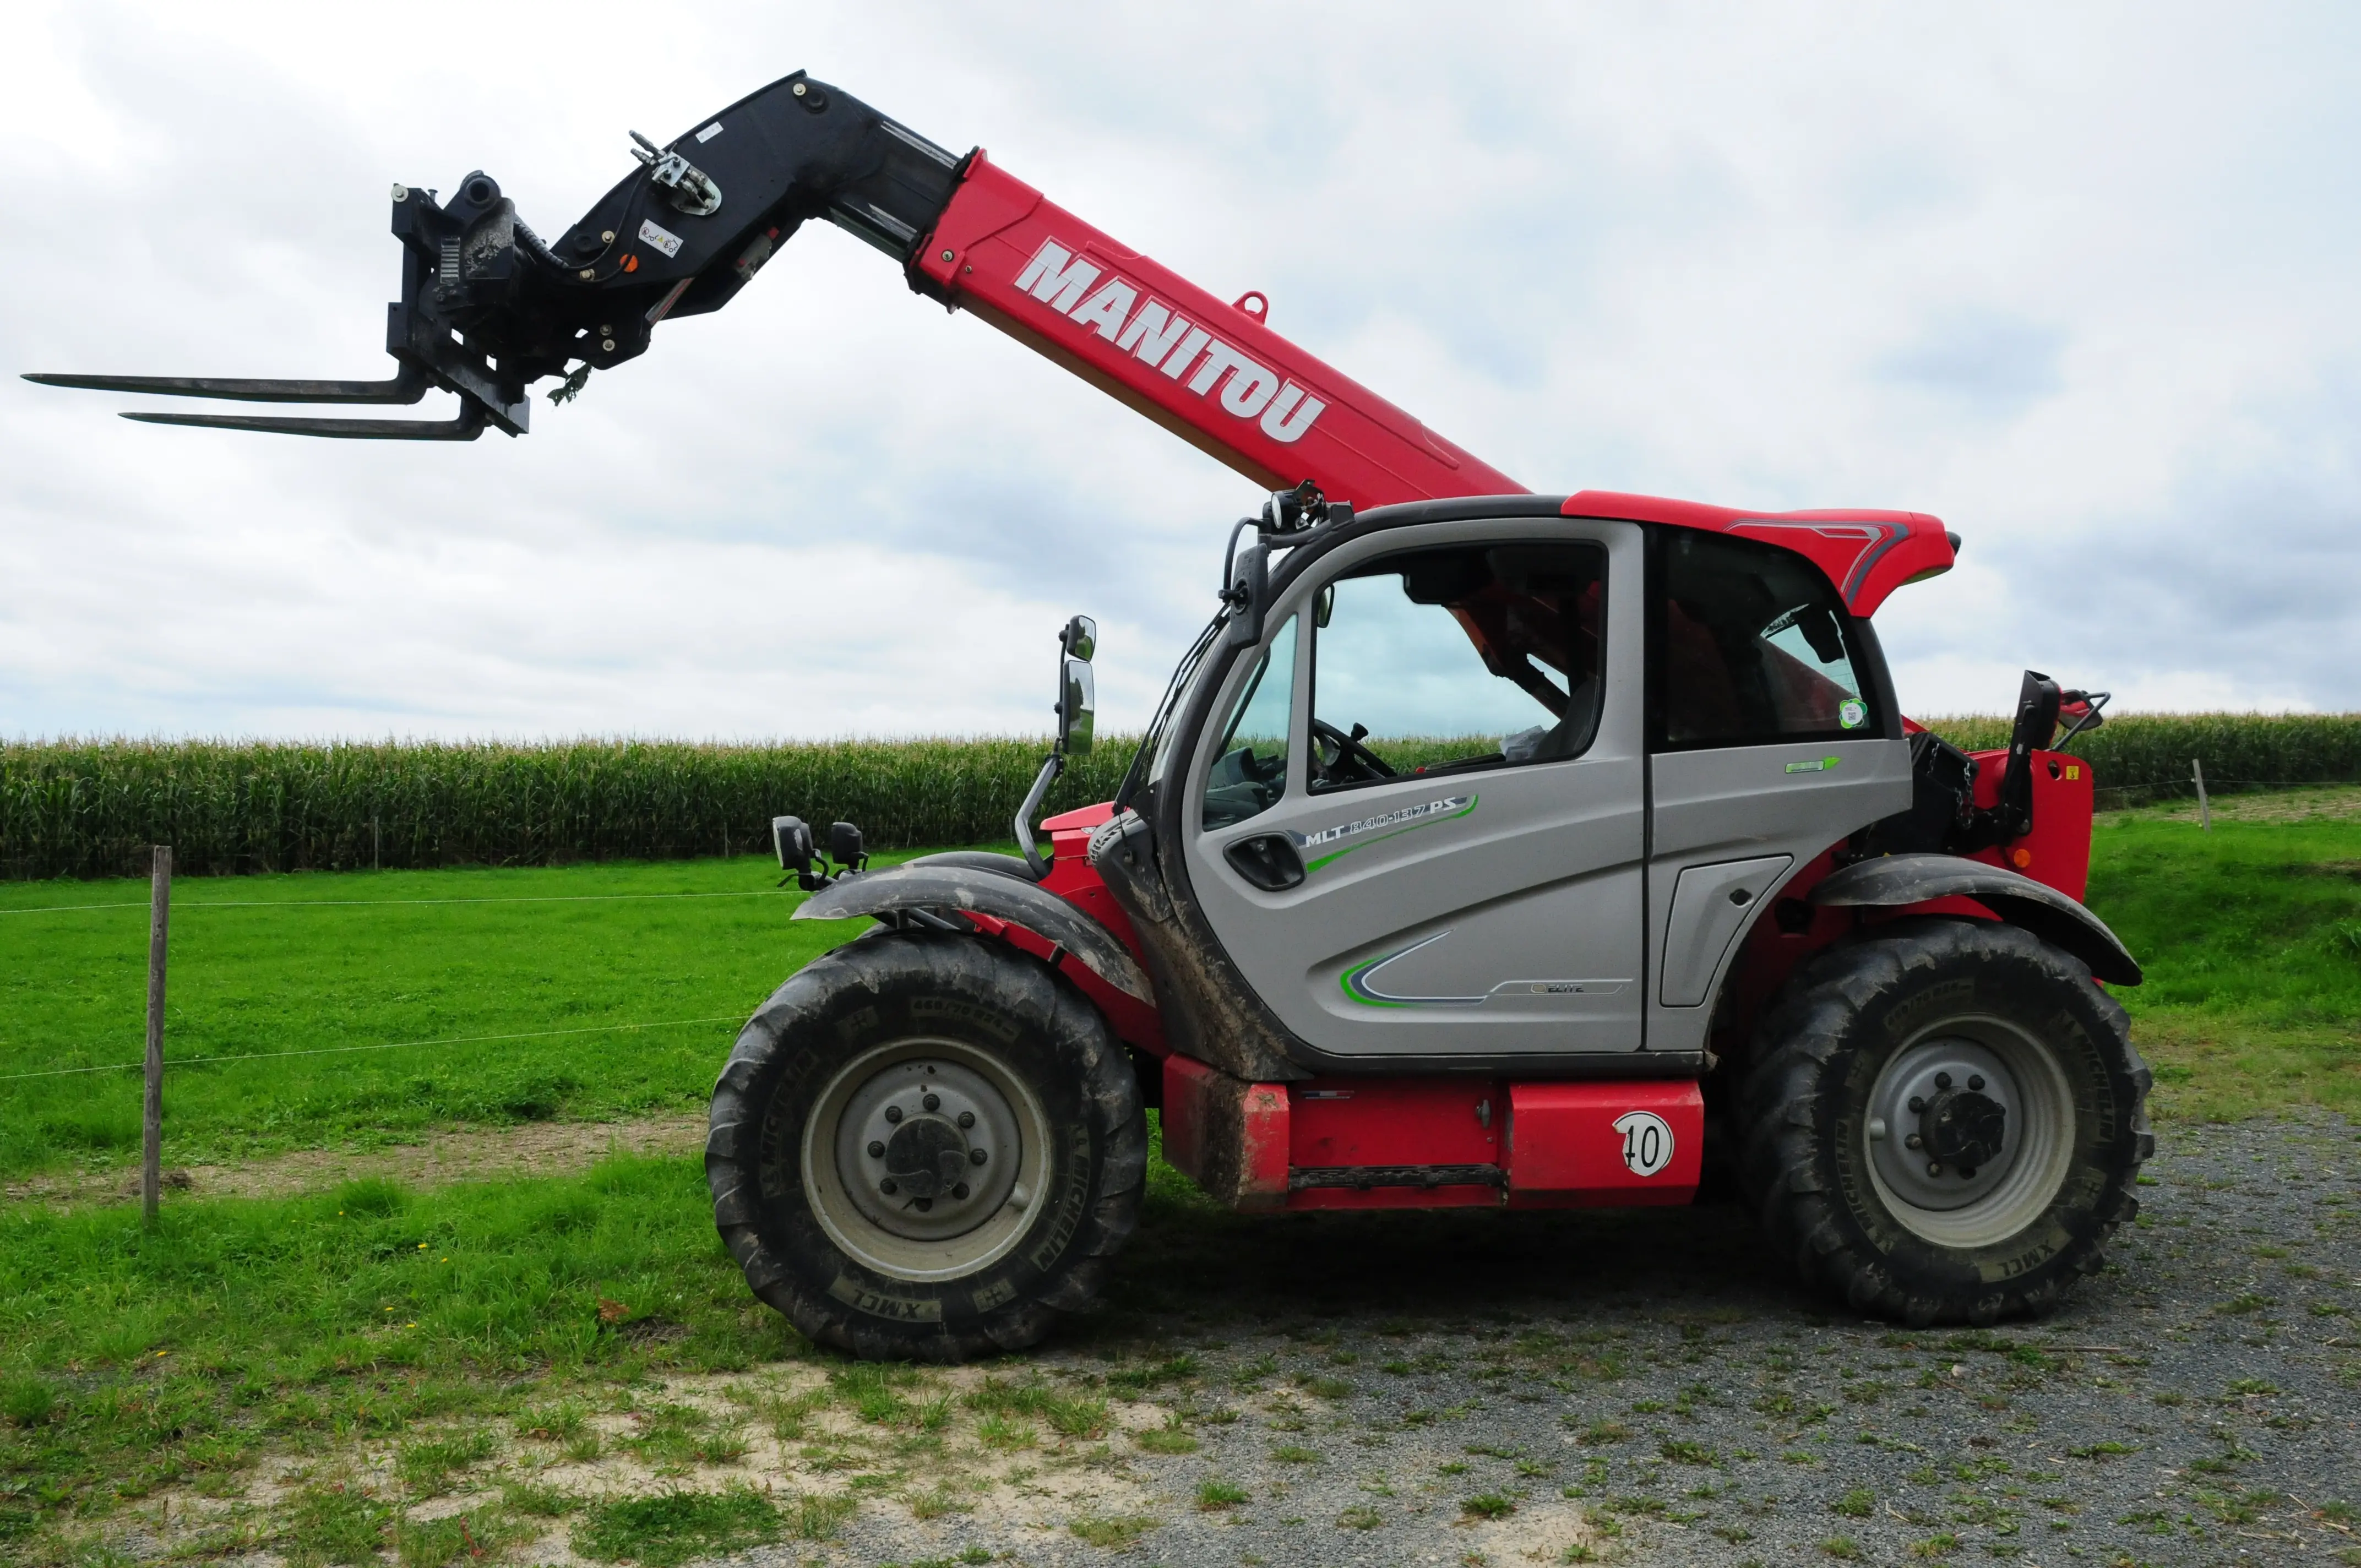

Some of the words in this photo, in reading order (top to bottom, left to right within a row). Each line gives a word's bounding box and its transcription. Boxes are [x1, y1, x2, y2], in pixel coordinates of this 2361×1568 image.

[1012, 237, 1328, 443] MANITOU
[1305, 825, 1345, 848] MLT
[1350, 804, 1426, 835] 840-137
[1430, 797, 1456, 814] PS
[1548, 984, 1584, 993] ELITE
[1837, 1121, 1876, 1233] MICHELIN
[1031, 1153, 1091, 1271] MICHELIN
[1998, 1240, 2055, 1276] XMCL
[851, 1289, 920, 1319] XMCL
